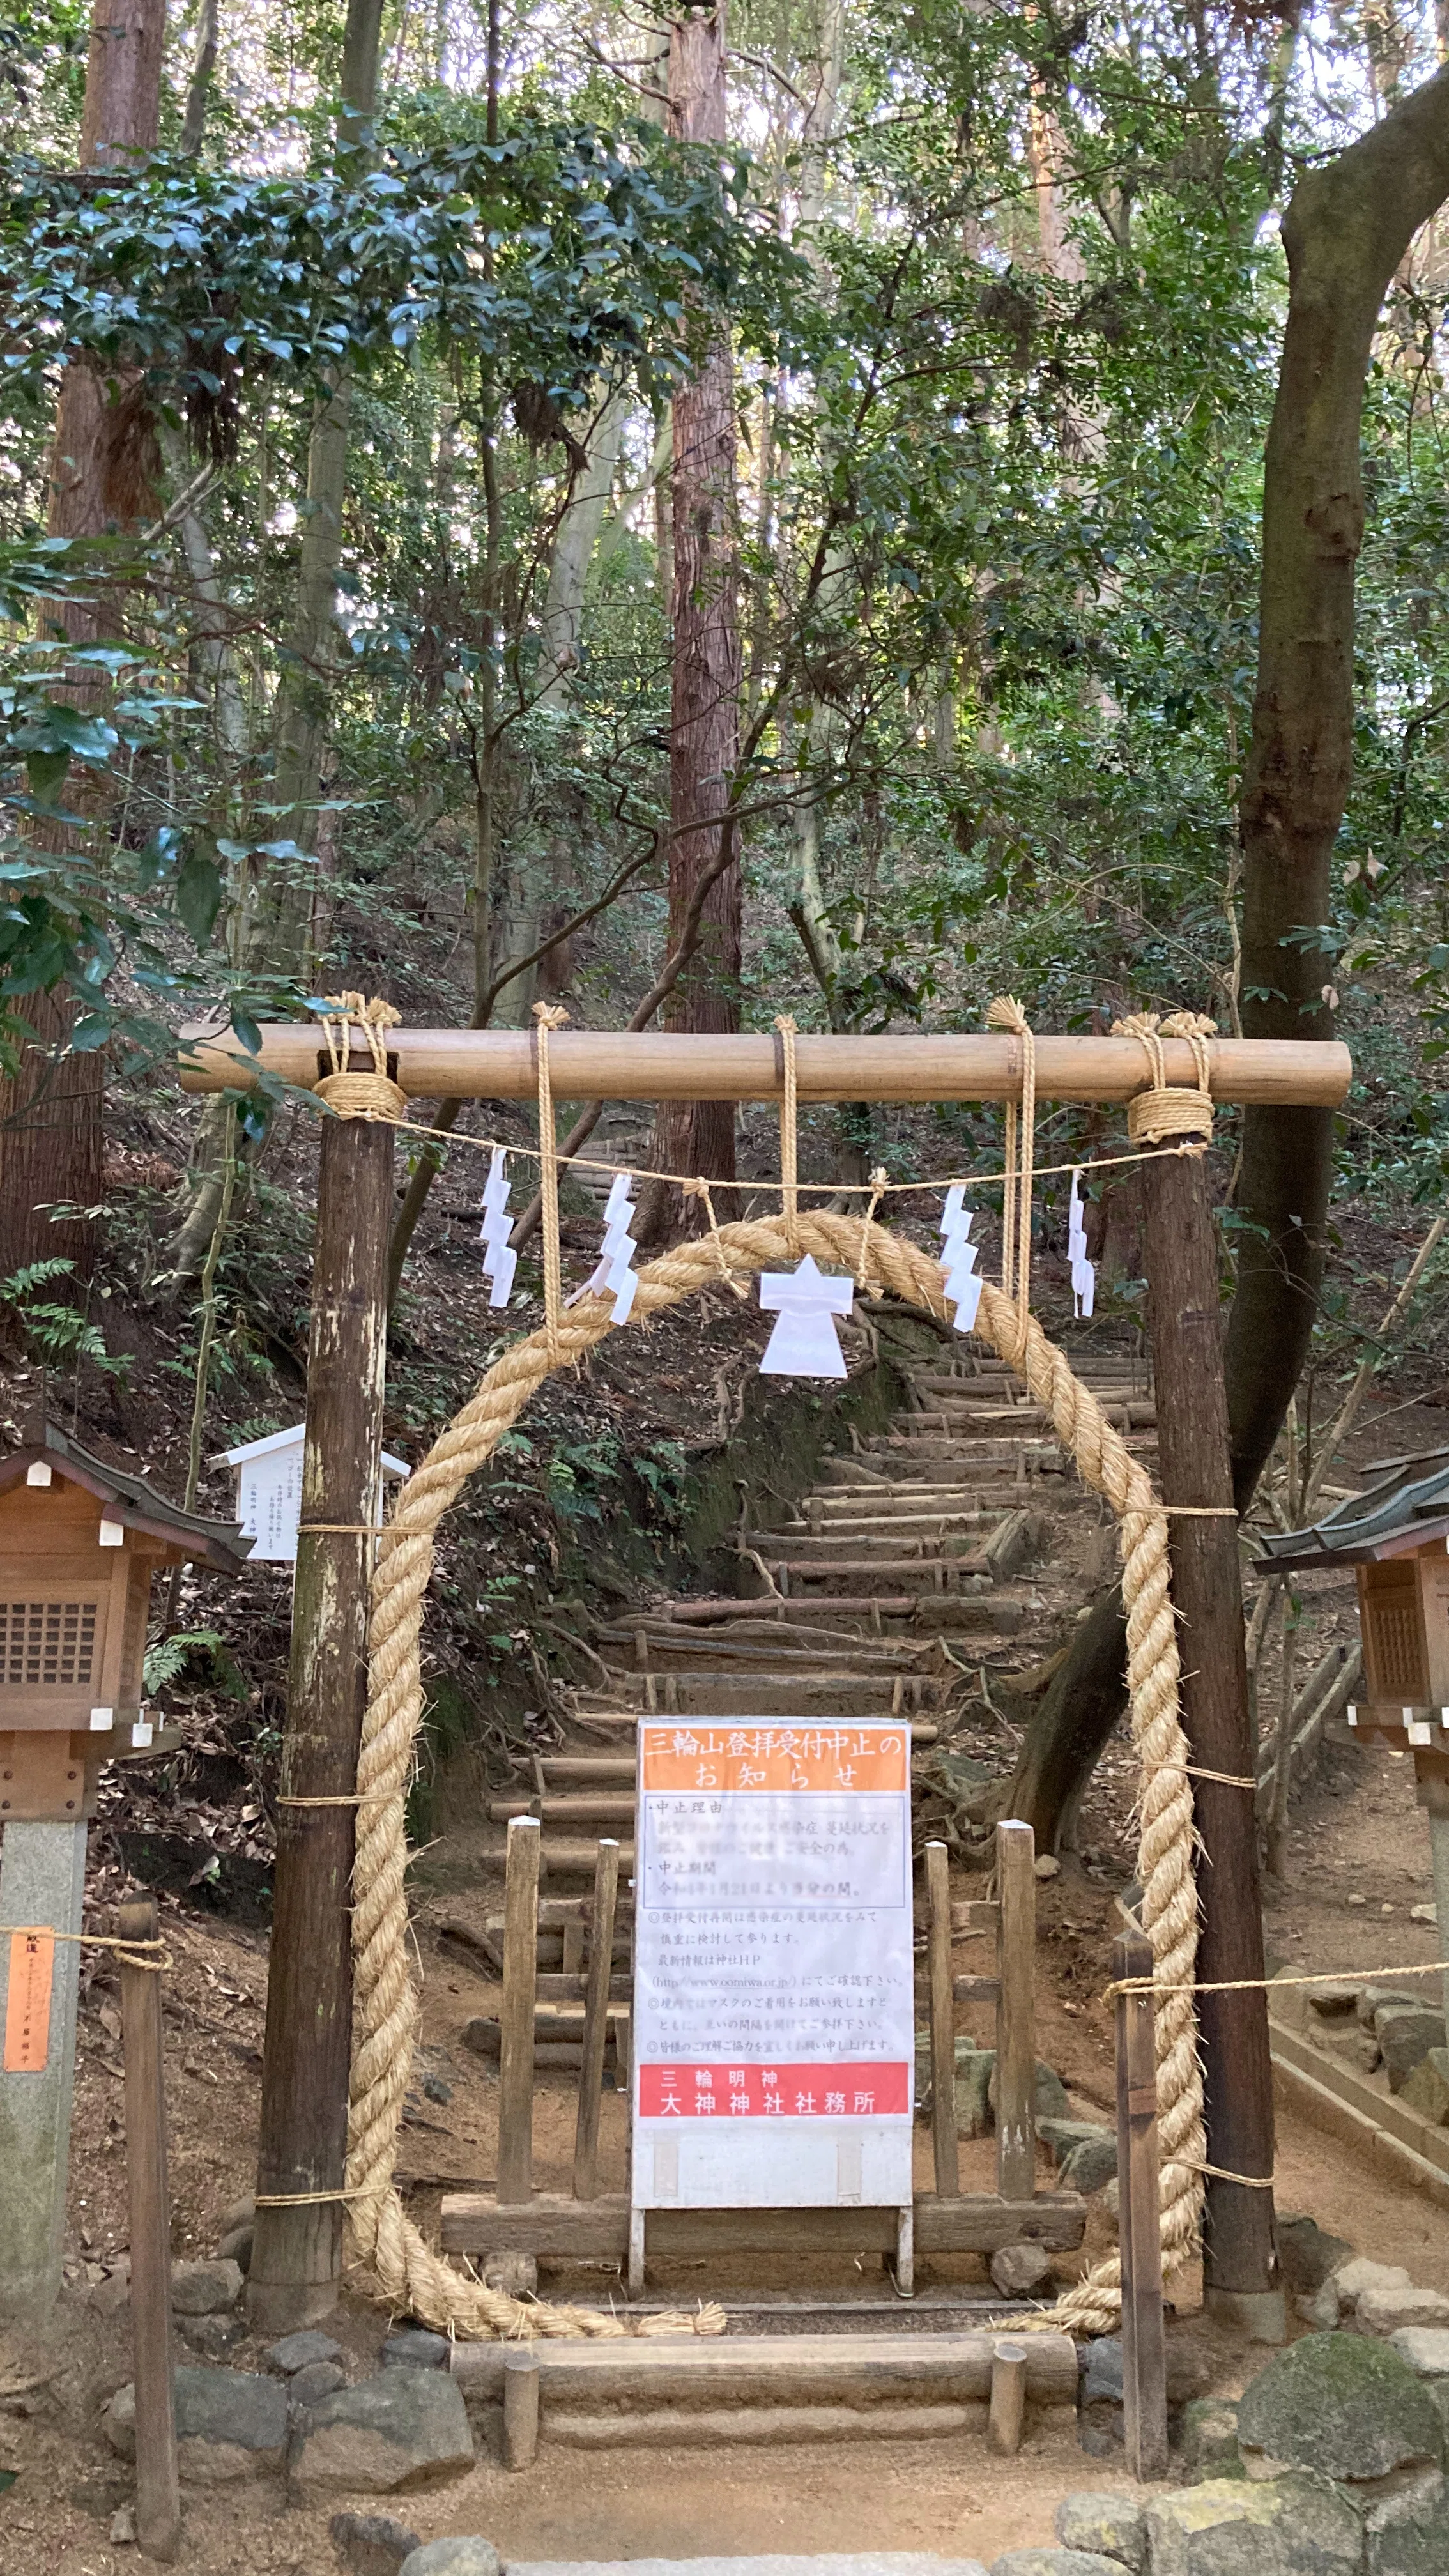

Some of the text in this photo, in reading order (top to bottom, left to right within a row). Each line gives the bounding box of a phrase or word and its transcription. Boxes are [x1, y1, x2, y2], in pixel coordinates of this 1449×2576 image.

[645, 1730, 901, 1759] 三輪山登拝受付中止の
[696, 1763, 857, 1788] お知らせ
[660, 1933, 801, 1946] 慎重に検討して参ります。
[660, 2070, 778, 2088] 三輪明神
[660, 2091, 875, 2115] 大神神社社務所
